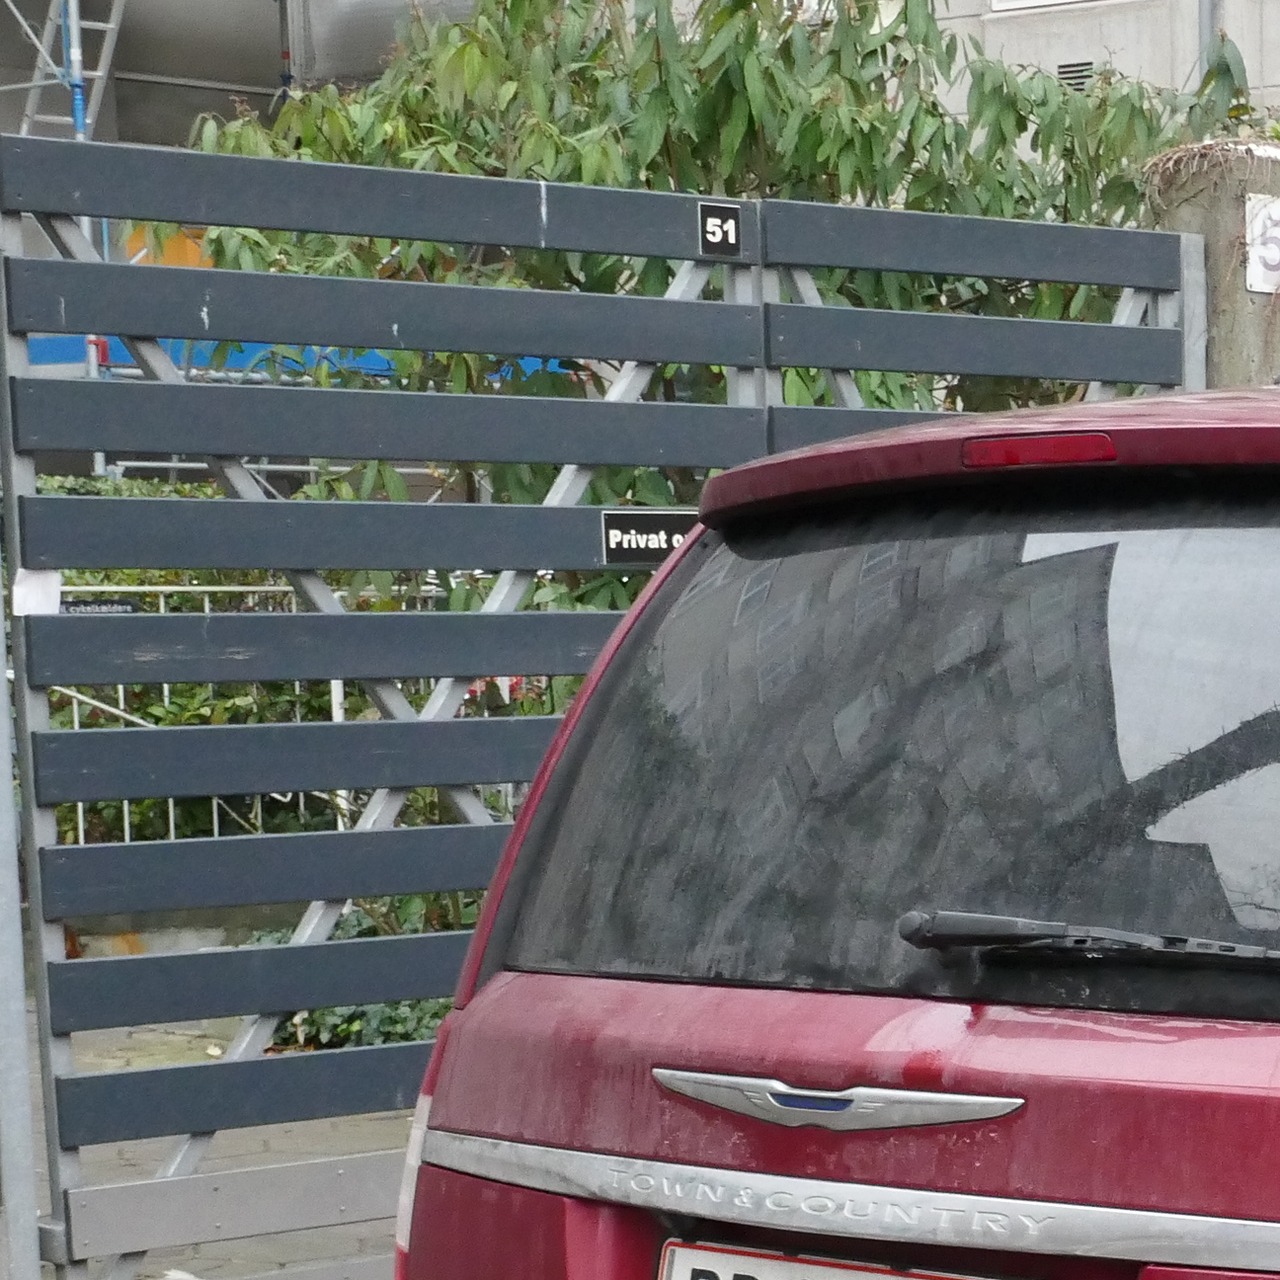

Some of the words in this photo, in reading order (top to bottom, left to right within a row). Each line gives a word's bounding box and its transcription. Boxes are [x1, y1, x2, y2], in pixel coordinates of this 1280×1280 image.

[706, 217, 736, 244] 51
[608, 529, 668, 549] Privat
[608, 1167, 728, 1204] TOWN
[764, 1190, 1057, 1235] COUNTRY
